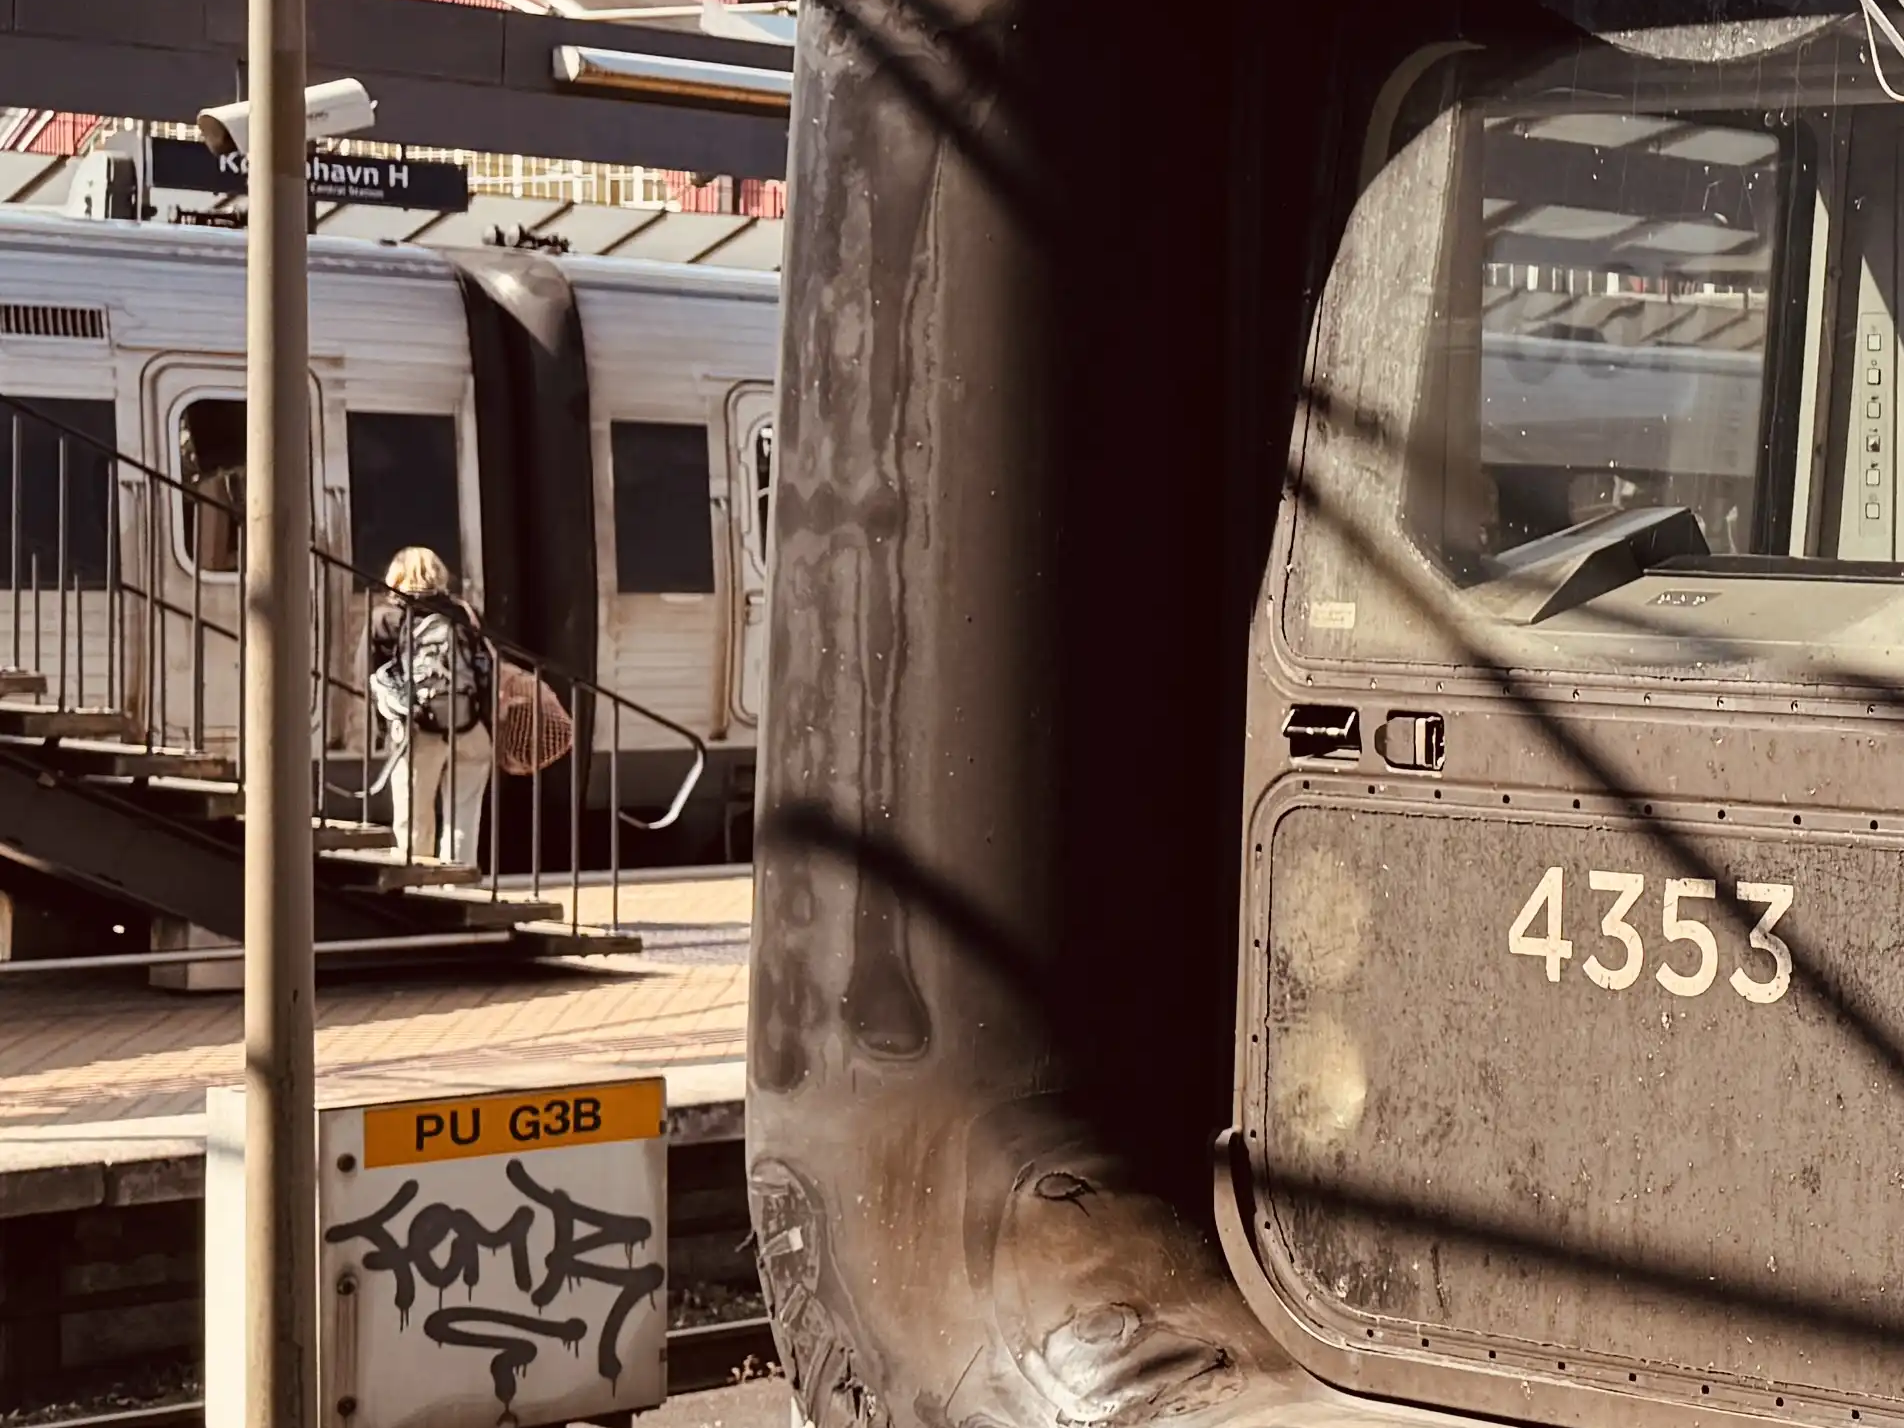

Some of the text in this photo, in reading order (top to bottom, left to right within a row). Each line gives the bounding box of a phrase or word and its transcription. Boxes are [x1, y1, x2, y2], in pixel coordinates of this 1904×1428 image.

[218, 150, 410, 190] Khavn H
[1508, 866, 1797, 1004] 4353
[414, 1098, 603, 1151] PU G3B
